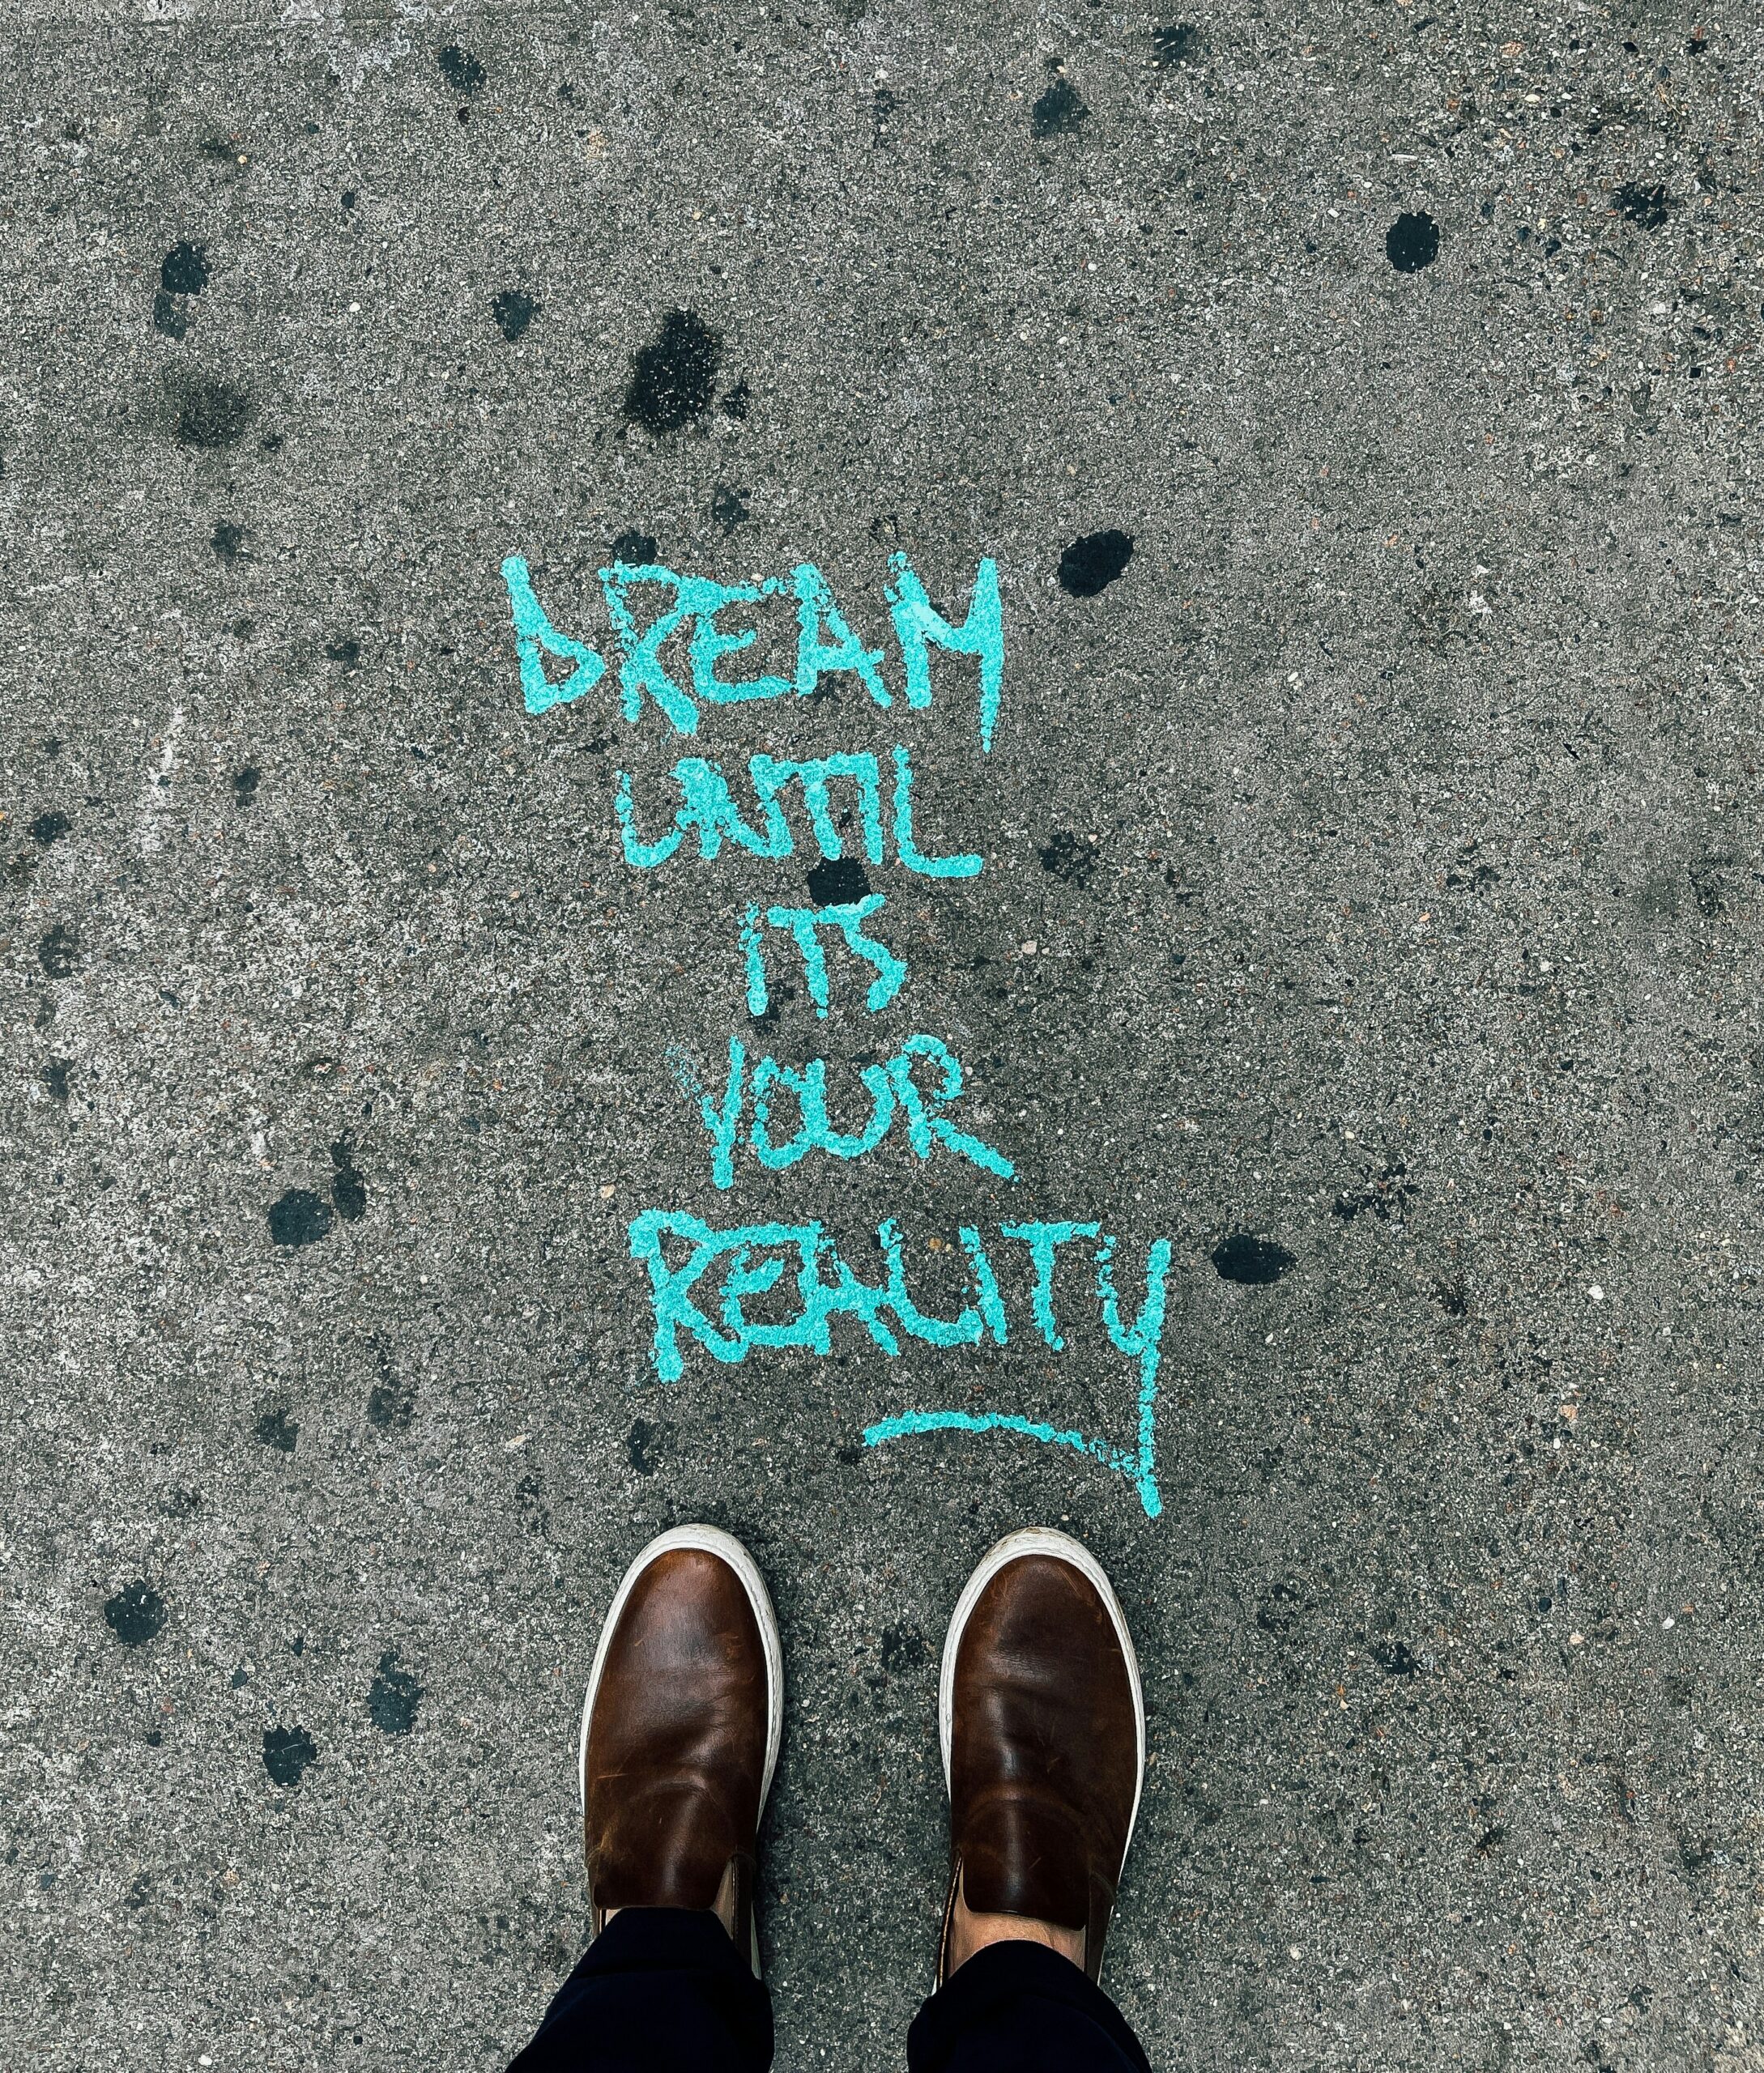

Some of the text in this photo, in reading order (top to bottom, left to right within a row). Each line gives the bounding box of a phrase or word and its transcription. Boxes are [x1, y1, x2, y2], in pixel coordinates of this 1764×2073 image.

[501, 551, 1003, 751] DREAM
[615, 745, 984, 877] UNTIL
[739, 894, 907, 1018] ITS
[667, 1034, 1018, 1190] YOUR
[628, 1209, 1171, 1517] REALITY
